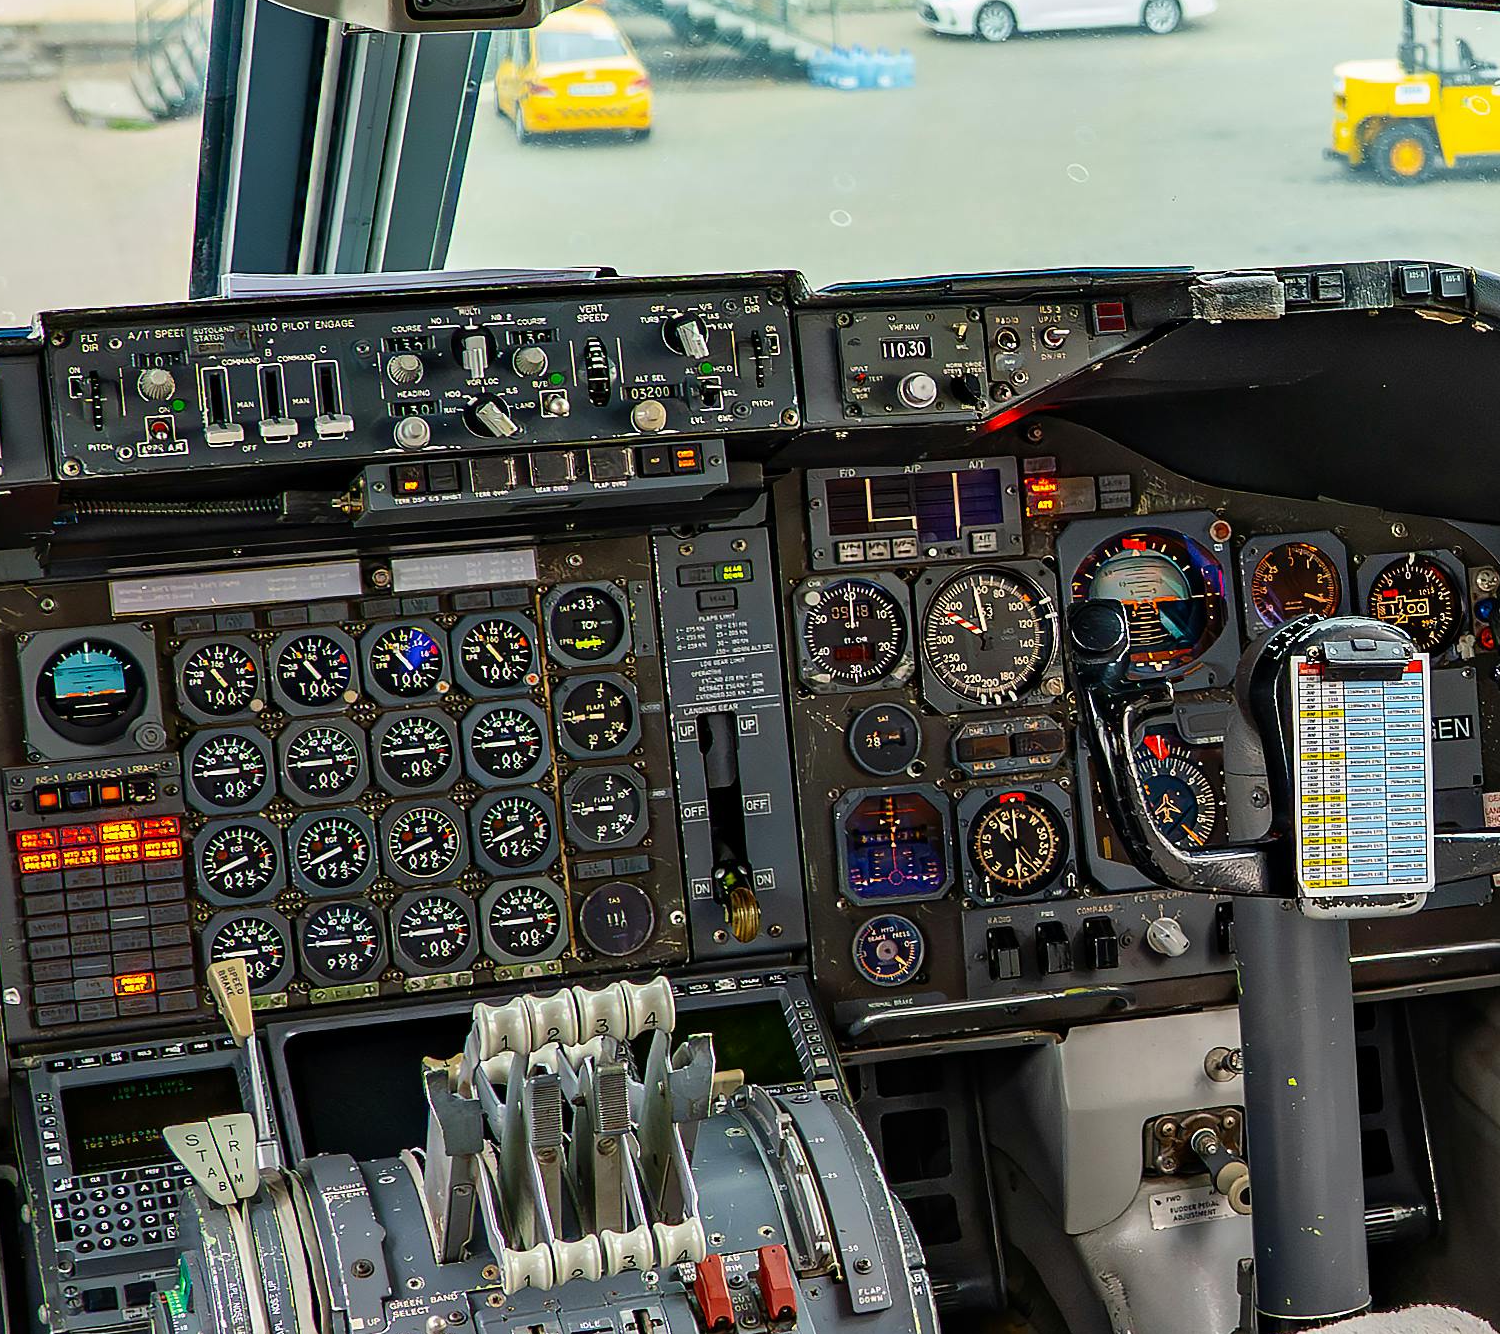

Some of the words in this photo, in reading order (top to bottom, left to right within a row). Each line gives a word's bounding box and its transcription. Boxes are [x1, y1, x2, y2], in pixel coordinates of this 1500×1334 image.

[459, 307, 480, 315] MULTI
[579, 304, 602, 313] VERT
[577, 313, 609, 322] SPEED
[252, 323, 278, 331] AUTO
[282, 321, 310, 331] PILOT
[315, 319, 354, 329] ENGAGE
[392, 325, 422, 333] COURSE
[193, 326, 234, 335] AUTOLAND
[81, 334, 97, 342] FLT
[194, 334, 224, 342] STATUS
[883, 341, 925, 357] 110.30
[222, 357, 261, 366] COMMAND
[277, 354, 316, 363] COMMAND
[397, 390, 430, 398] HEADING
[632, 387, 670, 399] 03200
[969, 460, 984, 468] A/T
[904, 465, 922, 473] A/P
[1009, 601, 1023, 611] 100
[1019, 619, 1032, 628] 120
[1020, 639, 1034, 647] 140
[1014, 656, 1028, 665] 160
[1000, 671, 1014, 681] 180
[982, 678, 999, 687] 200
[684, 706, 716, 715] LANDING
[718, 703, 738, 711] GEAR
[746, 799, 768, 811] OFF
[684, 806, 706, 817] OFF
[1077, 905, 1113, 915] COMPASS
[217, 970, 234, 997] BRAKE
[228, 966, 244, 995] SPEED
[859, 1287, 881, 1295] FLAP
[390, 1299, 424, 1310] GREEN
[430, 1291, 458, 1303] BAND
[859, 1295, 883, 1304] DOWN
[393, 1307, 430, 1319] SELECT
